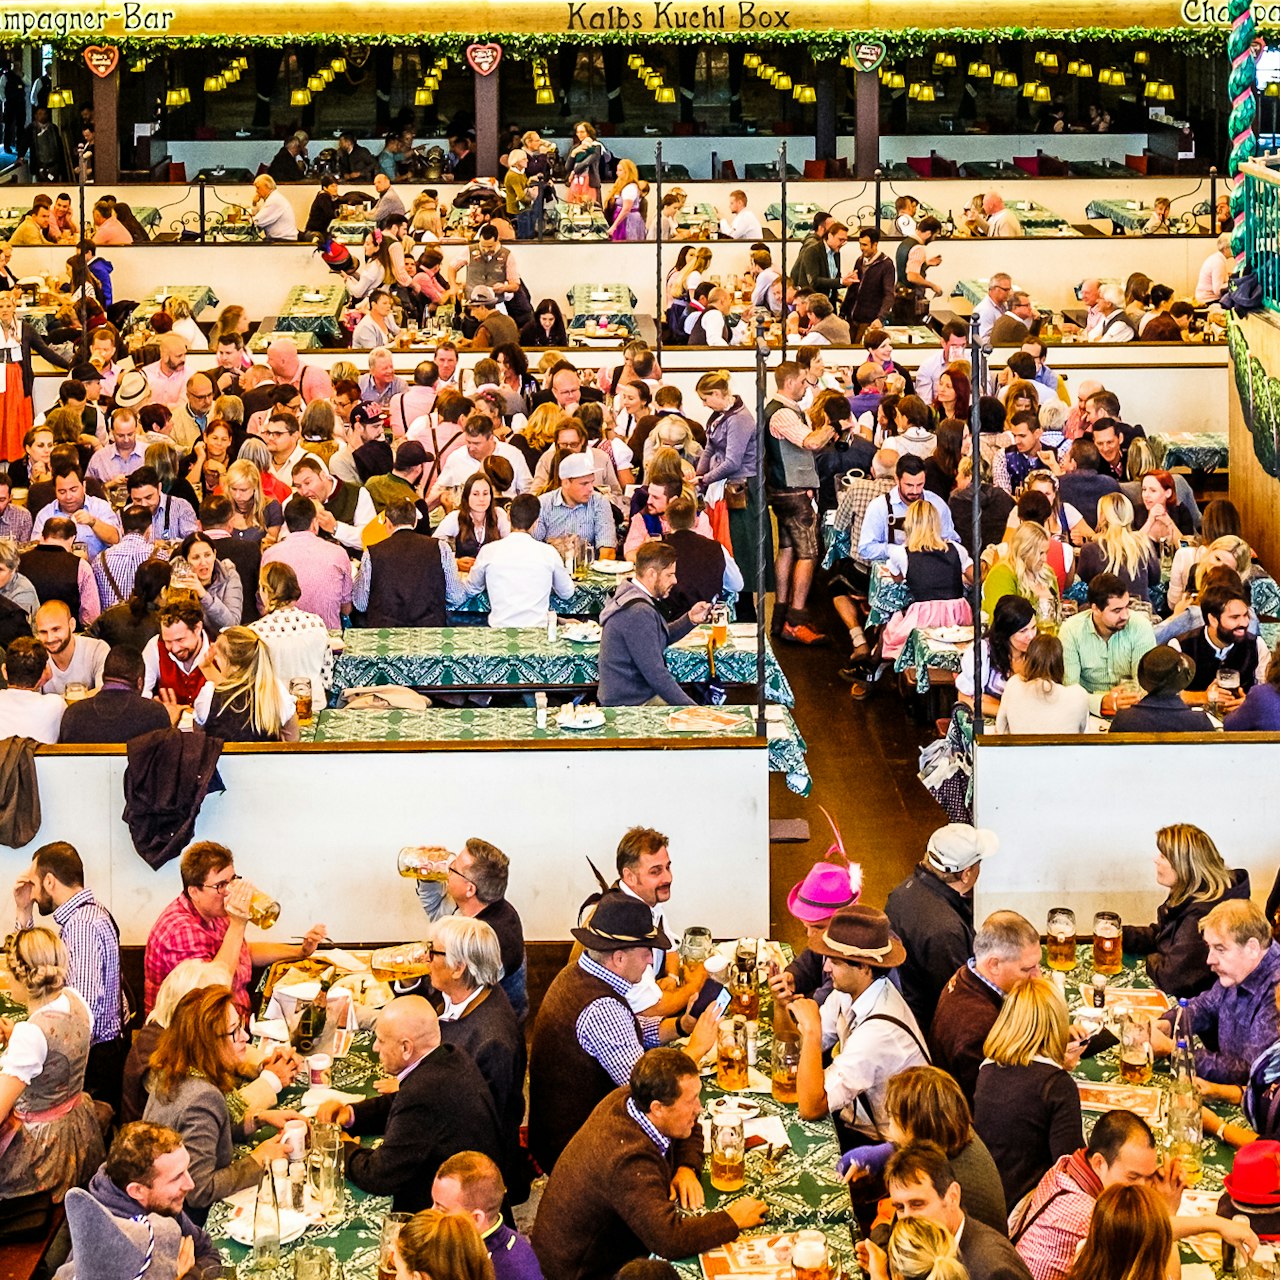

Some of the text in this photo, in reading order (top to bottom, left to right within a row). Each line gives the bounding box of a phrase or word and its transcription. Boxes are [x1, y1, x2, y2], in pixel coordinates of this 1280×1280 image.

[567, 0, 791, 31] Kalbs Kuchl Box
